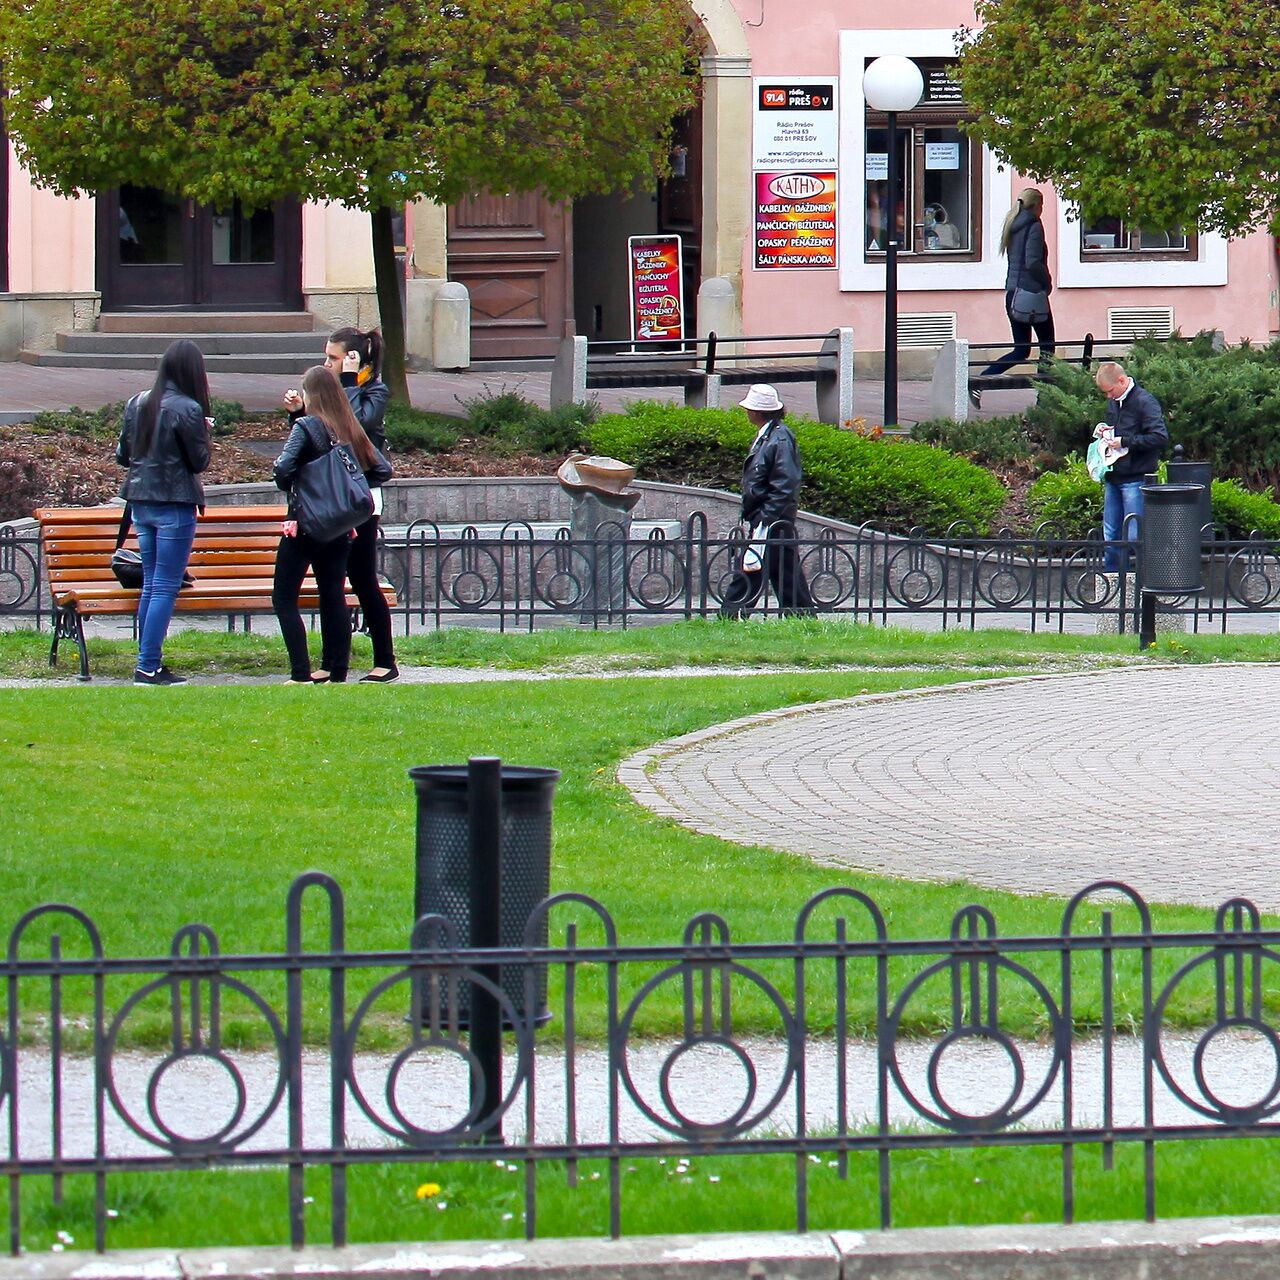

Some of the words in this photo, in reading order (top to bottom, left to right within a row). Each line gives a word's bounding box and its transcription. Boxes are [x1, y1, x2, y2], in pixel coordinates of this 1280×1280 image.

[765, 93, 785, 103] 91.4
[776, 177, 817, 195] KATHY
[759, 204, 791, 213] KABELKY
[756, 219, 796, 230] PANČUCHY
[757, 238, 787, 247] OPASKY
[758, 254, 777, 264] ŠÁLY
[778, 254, 808, 264] PÁNSKA
[809, 253, 833, 263] MÓDA
